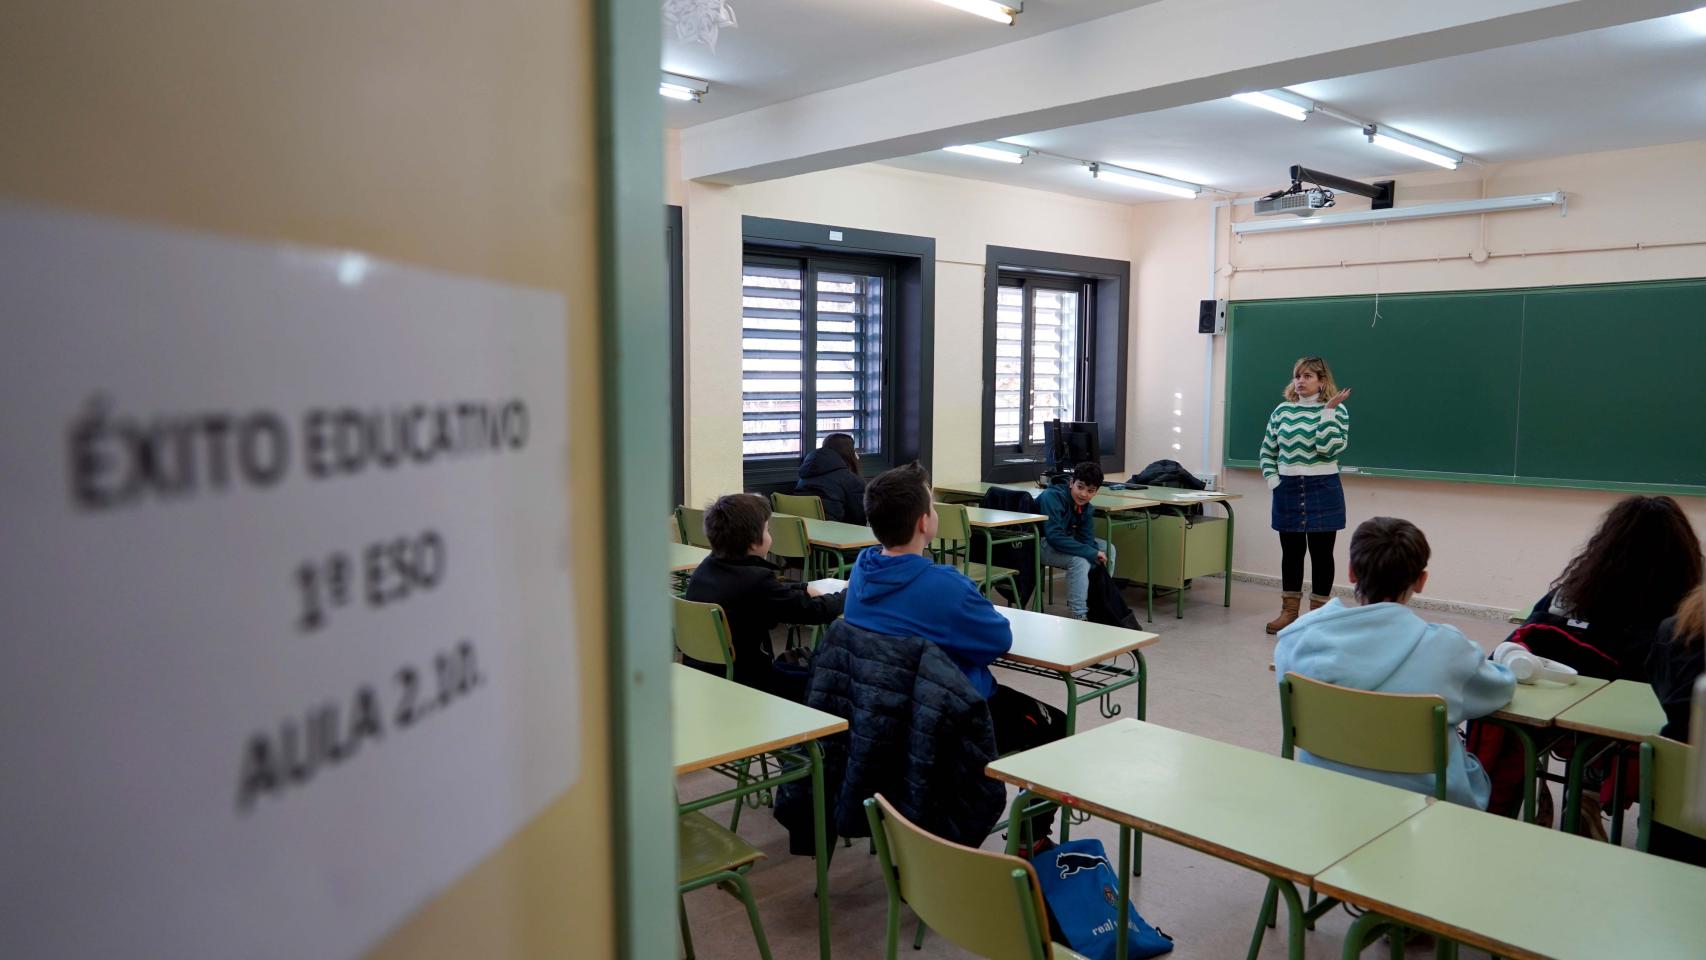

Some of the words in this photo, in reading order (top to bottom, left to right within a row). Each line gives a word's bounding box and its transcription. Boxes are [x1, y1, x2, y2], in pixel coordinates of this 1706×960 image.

[67, 391, 290, 512] ÉXITO
[302, 397, 528, 480] EDUCATIVO
[363, 530, 445, 607] ESO
[237, 686, 385, 813] AULA
[1092, 918, 1114, 936] real
